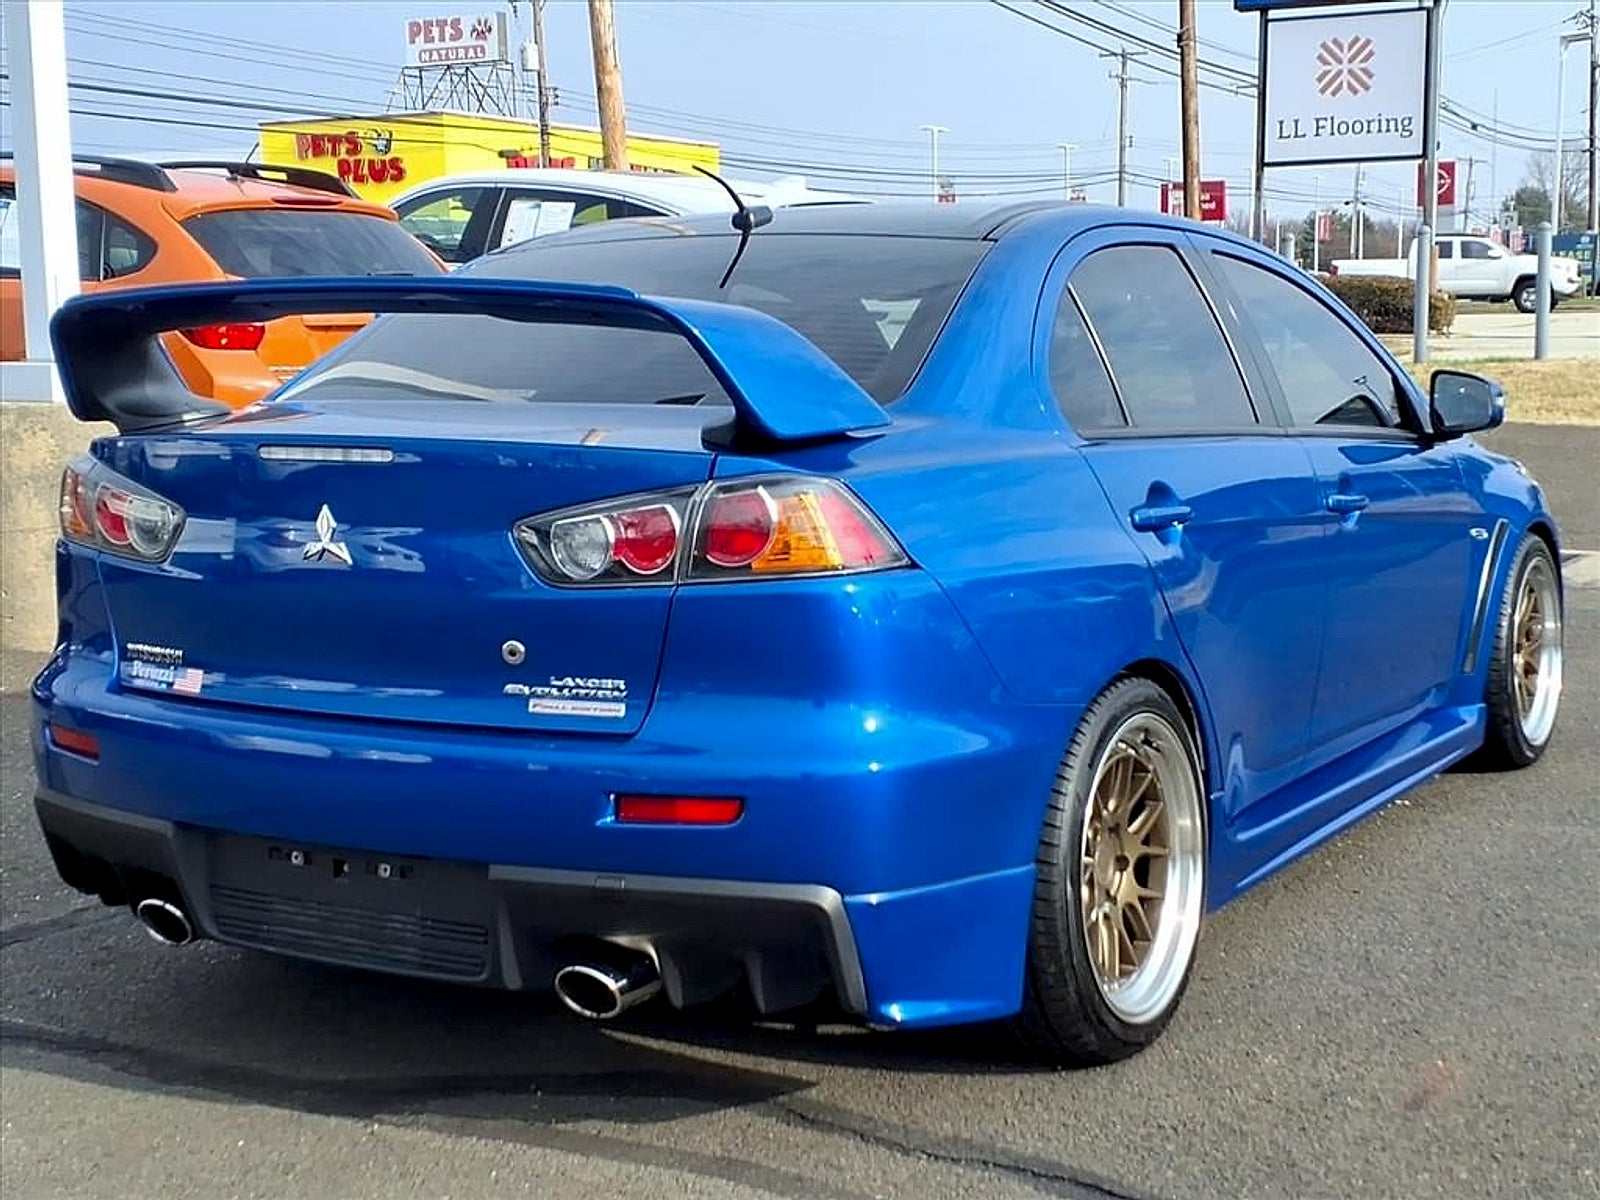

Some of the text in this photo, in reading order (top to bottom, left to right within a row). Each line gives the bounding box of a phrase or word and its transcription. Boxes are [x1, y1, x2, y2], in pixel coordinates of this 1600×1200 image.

[408, 18, 464, 44] PETS
[421, 48, 484, 62] NATURAL
[1277, 112, 1413, 139] LL Flooring
[297, 131, 362, 161] PETS
[338, 157, 406, 184] PLUS
